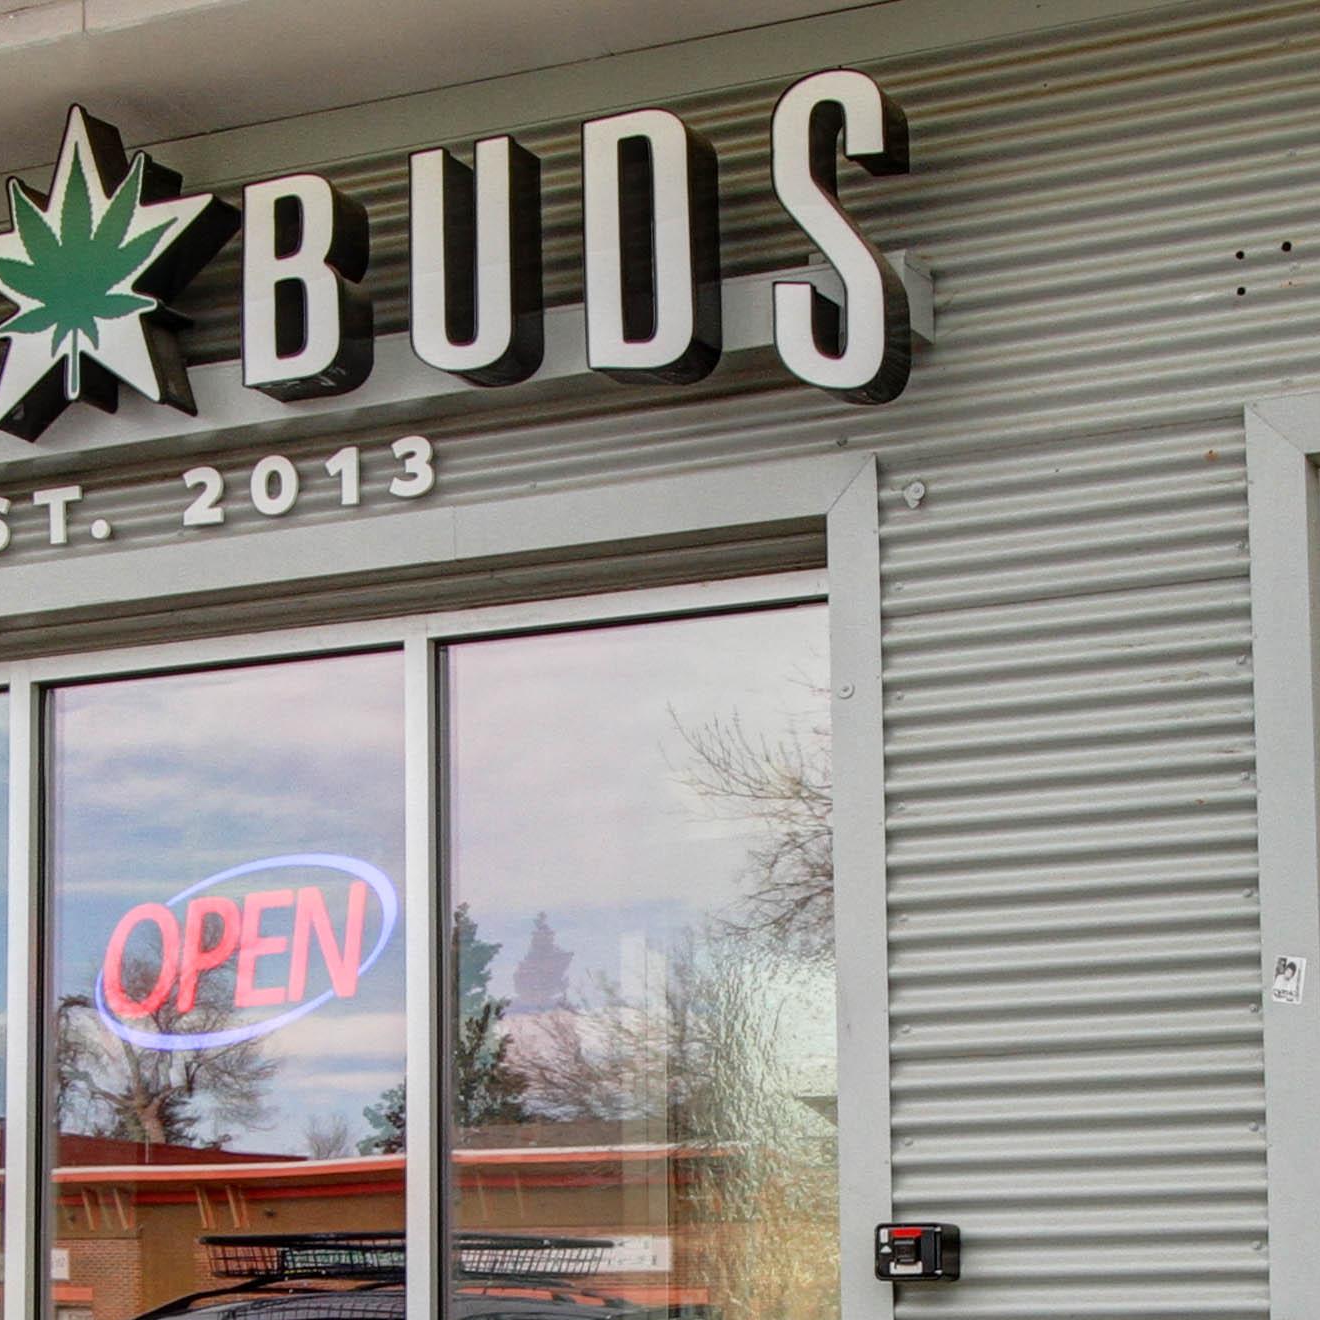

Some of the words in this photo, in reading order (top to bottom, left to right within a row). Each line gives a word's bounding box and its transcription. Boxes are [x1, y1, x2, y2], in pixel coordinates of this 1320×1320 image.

[241, 68, 893, 396] BUDS
[182, 435, 437, 528] 2013
[102, 880, 368, 1019] OPEN
